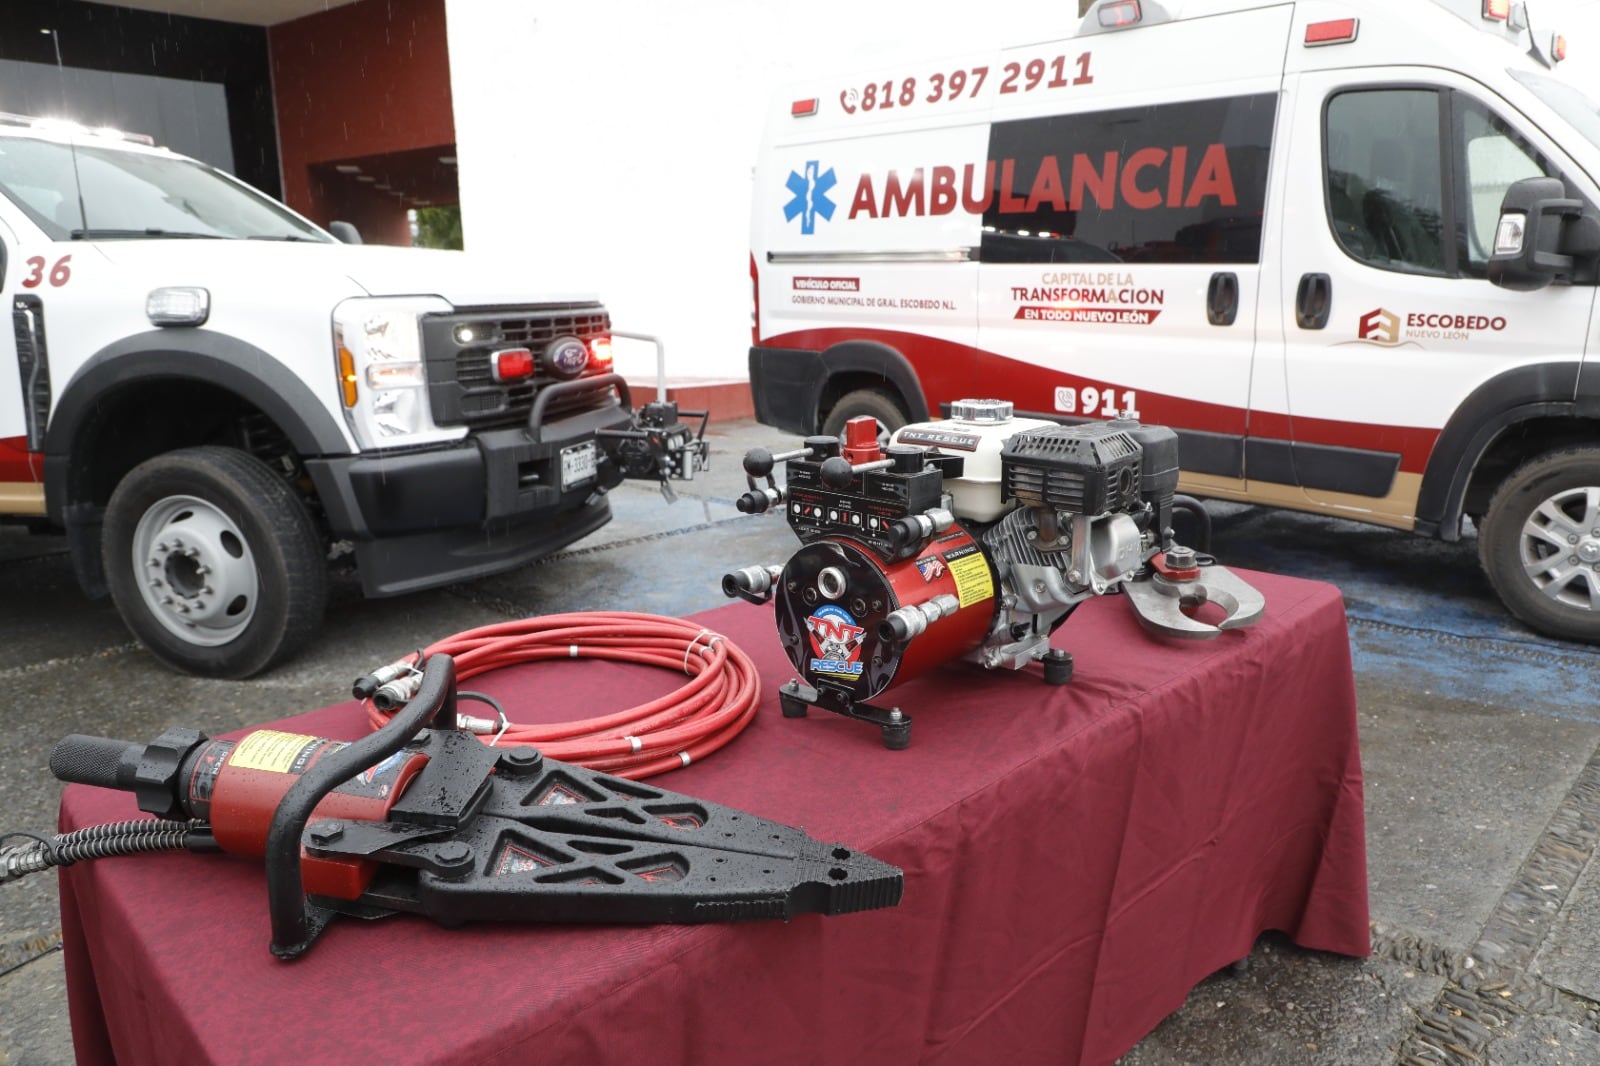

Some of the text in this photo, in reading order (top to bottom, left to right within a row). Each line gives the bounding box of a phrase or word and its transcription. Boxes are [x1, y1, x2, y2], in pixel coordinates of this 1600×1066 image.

[860, 51, 1094, 112] 818 397 2911
[848, 143, 1238, 220] AMBULANCIA
[21, 254, 72, 288] 36
[1042, 272, 1134, 286] CAPITAL DE LA
[795, 278, 858, 291] VEHÍCULO OFICIAL
[792, 295, 825, 305] GOBIERNO
[827, 296, 865, 307] MUNICIPAL
[867, 298, 875, 307] DE
[900, 299, 940, 310] ESCOBEDO
[943, 301, 957, 310] N.L.
[1024, 308, 1149, 324] EN TODO NUEVO LEÓN
[1407, 313, 1507, 331] ESCOBEDO
[1405, 330, 1441, 339] NUEVO
[1080, 386, 1141, 420] 911
[903, 431, 975, 445] TNT RESCUE
[807, 616, 864, 642] TNT
[810, 658, 864, 675] RESCUE
[211, 751, 228, 775] OPEN
